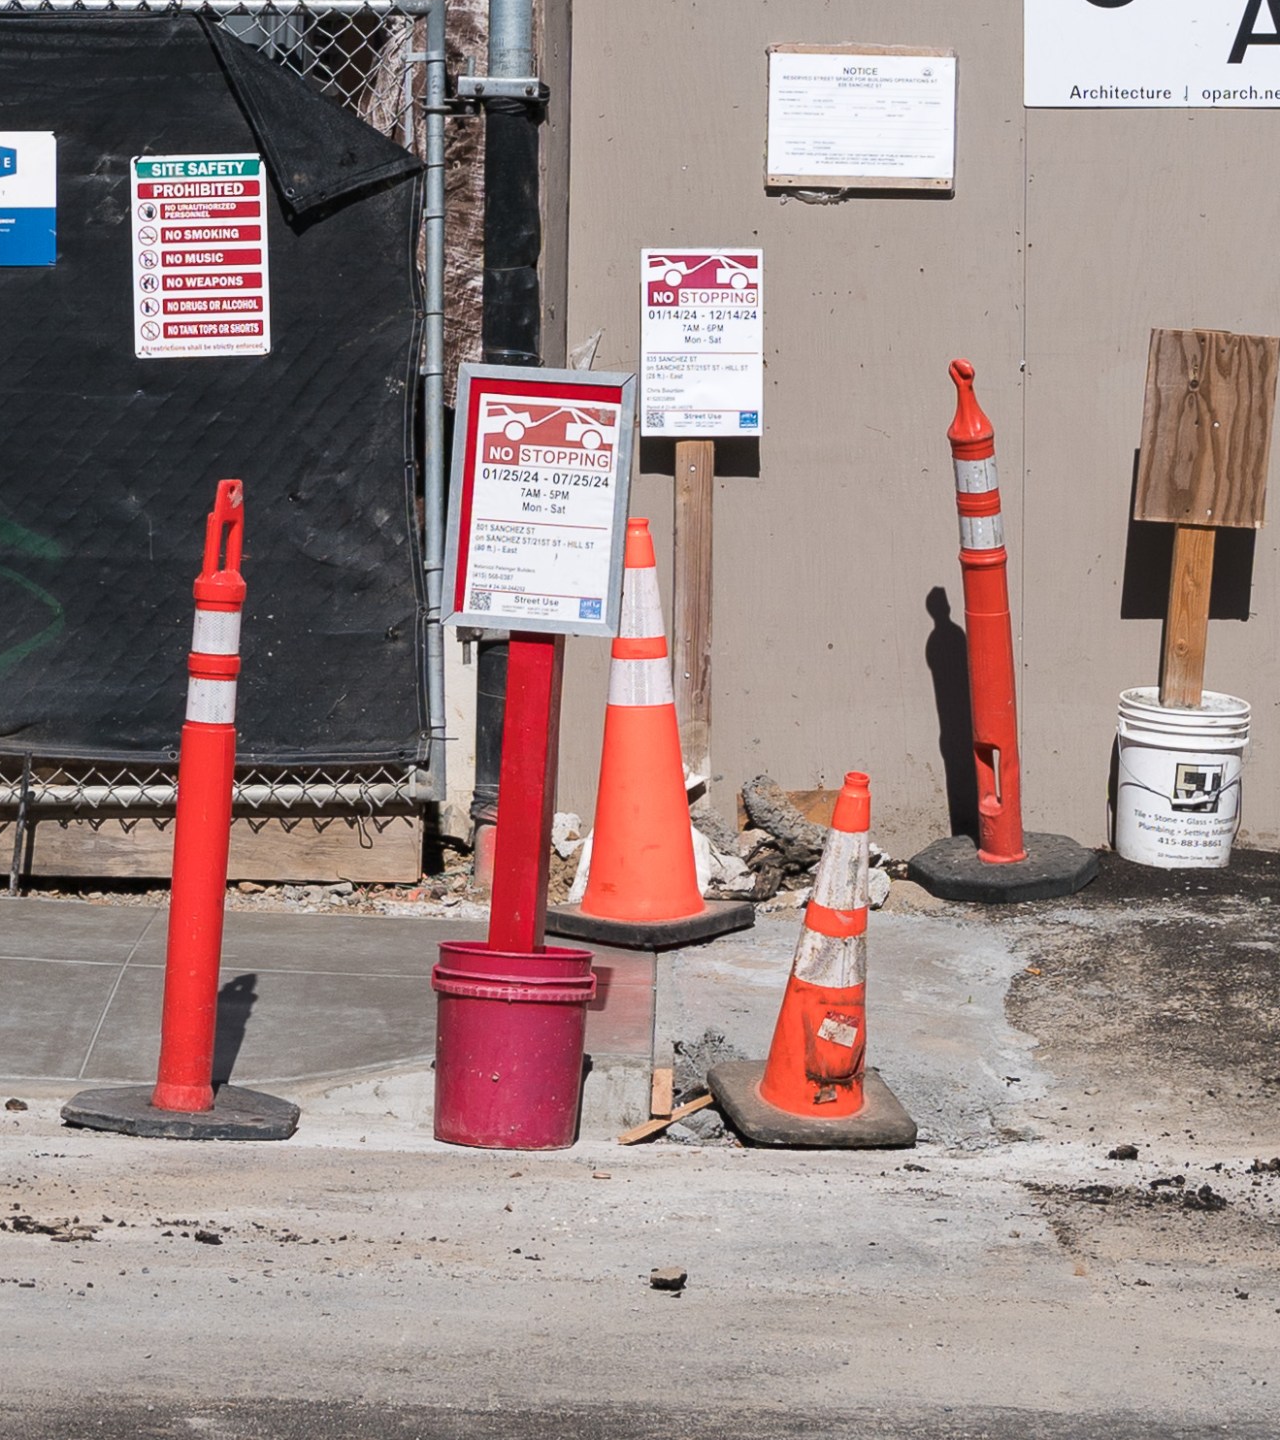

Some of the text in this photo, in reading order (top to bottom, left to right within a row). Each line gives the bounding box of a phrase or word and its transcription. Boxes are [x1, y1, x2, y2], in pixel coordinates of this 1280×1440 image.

[842, 67, 878, 76] NOTICE
[1069, 84, 1172, 100] Architecture
[151, 161, 245, 176] SITE SAFETY
[152, 182, 245, 197] PROHIBITED
[177, 202, 237, 211] UNAUTHORIZED
[164, 211, 211, 219] PERSONNEL
[165, 228, 239, 240] NO SMOKING
[166, 252, 224, 264] NO MUSIC
[166, 276, 244, 288] NO WEAPONS
[653, 291, 756, 304] NO STOPPING
[167, 299, 258, 312] NO DRUGS OR ALCOHOL
[648, 310, 757, 320] 01/14/24 12/14/24
[167, 323, 260, 335] NO TANK TOPS OR SHORTS
[682, 324, 724, 332] 7AM 6PM
[684, 335, 722, 344] Mon Sat
[187, 343, 203, 351] shall
[213, 343, 234, 351] strictly
[489, 445, 610, 468] NO STOPPING
[482, 467, 609, 488] 01/25/24 07/25/24
[521, 487, 570, 500] 7AM 5PM
[522, 502, 566, 514] Mon Sat
[490, 524, 524, 533] SANCHEZ
[526, 527, 535, 535] ST
[486, 535, 521, 544] SANCHEZ
[522, 537, 550, 547] ST/21ST
[552, 539, 561, 548] ST
[567, 540, 583, 549] HILL
[585, 541, 595, 550] ST
[502, 546, 518, 554] East
[514, 595, 560, 607] Street Use
[1134, 808, 1147, 819] Tile
[1154, 813, 1178, 824] Stone
[1186, 817, 1207, 826] Glass
[1138, 821, 1175, 836] Plumbing
[1183, 828, 1210, 838] Setting
